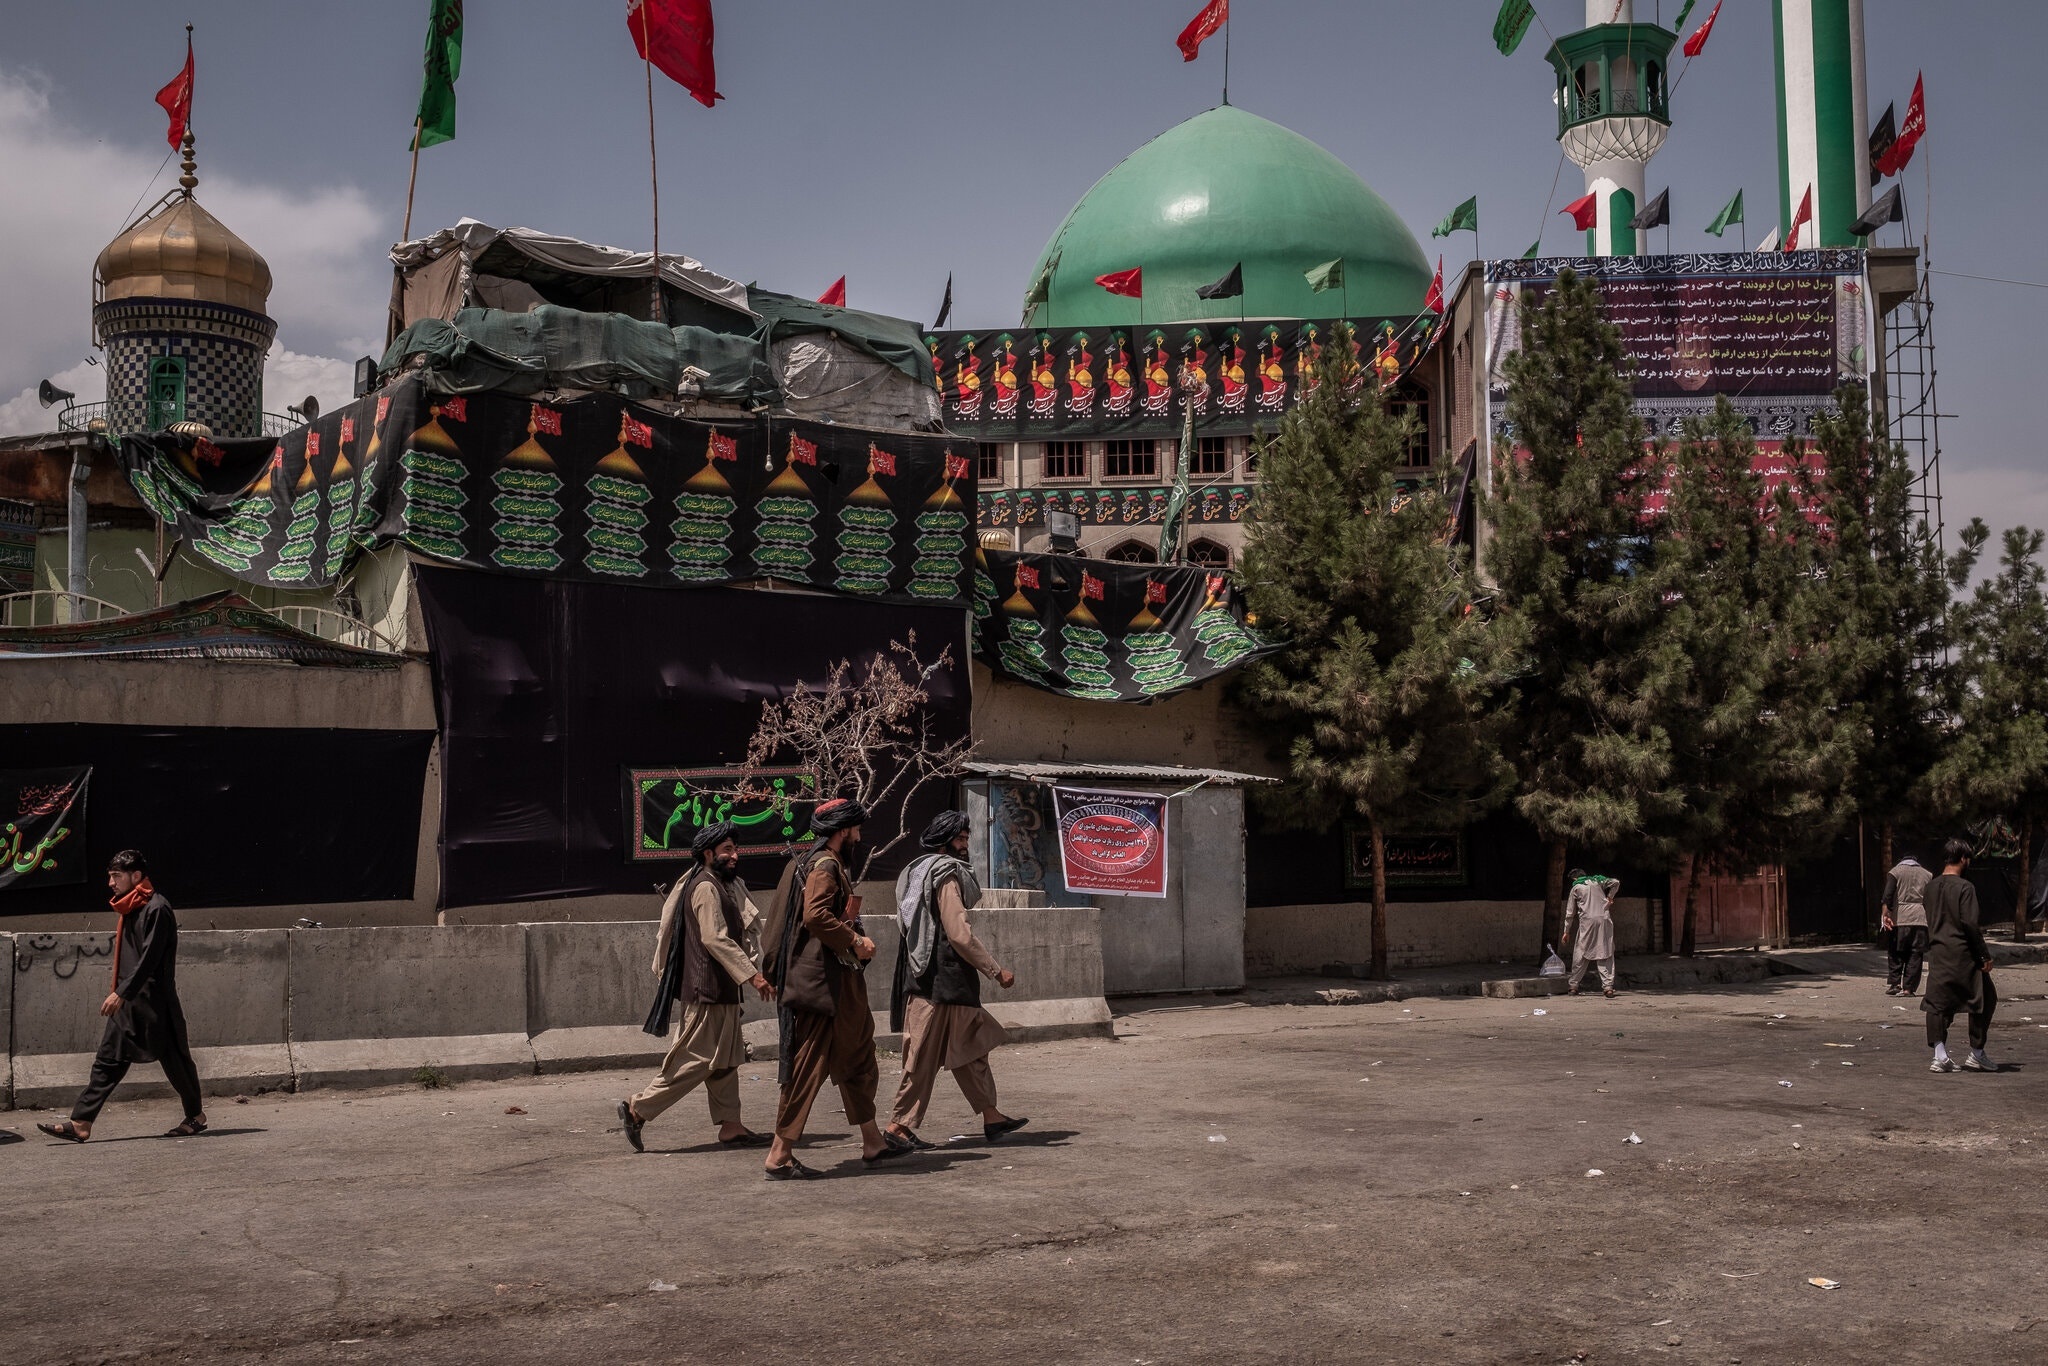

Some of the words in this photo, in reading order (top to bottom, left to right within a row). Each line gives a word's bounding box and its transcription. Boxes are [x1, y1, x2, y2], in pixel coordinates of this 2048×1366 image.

[1662, 283, 1668, 291] را
[1697, 282, 1714, 290] حسن
[1725, 281, 1741, 290] کسی
[1743, 280, 1774, 291] فرمودند:
[1776, 280, 1794, 291] (ص)
[1797, 280, 1811, 289] خدا
[1813, 280, 1833, 290] رسول
[1687, 298, 1707, 307] دشمن
[1709, 298, 1715, 307] را
[1728, 298, 1746, 307] بدارد
[1747, 298, 1766, 307] دشمن
[1769, 298, 1775, 307] را
[1776, 299, 1795, 307] حسین
[1803, 298, 1820, 306] حسن
[1631, 317, 1651, 325] حسین
[1654, 316, 1660, 325] از
[1680, 314, 1696, 322] است
[1698, 316, 1708, 324] من
[1710, 314, 1717, 323] از
[1718, 315, 1739, 323] حسین
[1740, 312, 1773, 324] فرمودند:
[1776, 312, 1794, 323] (ص)
[1797, 312, 1812, 321] خدا
[1814, 311, 1834, 323] رسول
[1676, 333, 1683, 343] از
[1758, 333, 1780, 341] دوست
[1781, 332, 1788, 341] را
[1790, 332, 1810, 341] حسین
[1823, 331, 1830, 340] را
[1651, 351, 1671, 360] رسول
[1762, 349, 1768, 358] از
[1664, 368, 1683, 378] کرده
[1702, 369, 1713, 377] من
[1714, 367, 1720, 376] با
[1736, 368, 1751, 377] صلح
[1767, 366, 1773, 376] با
[1786, 369, 1796, 377] هر
[1799, 366, 1831, 376] فرمودند:
